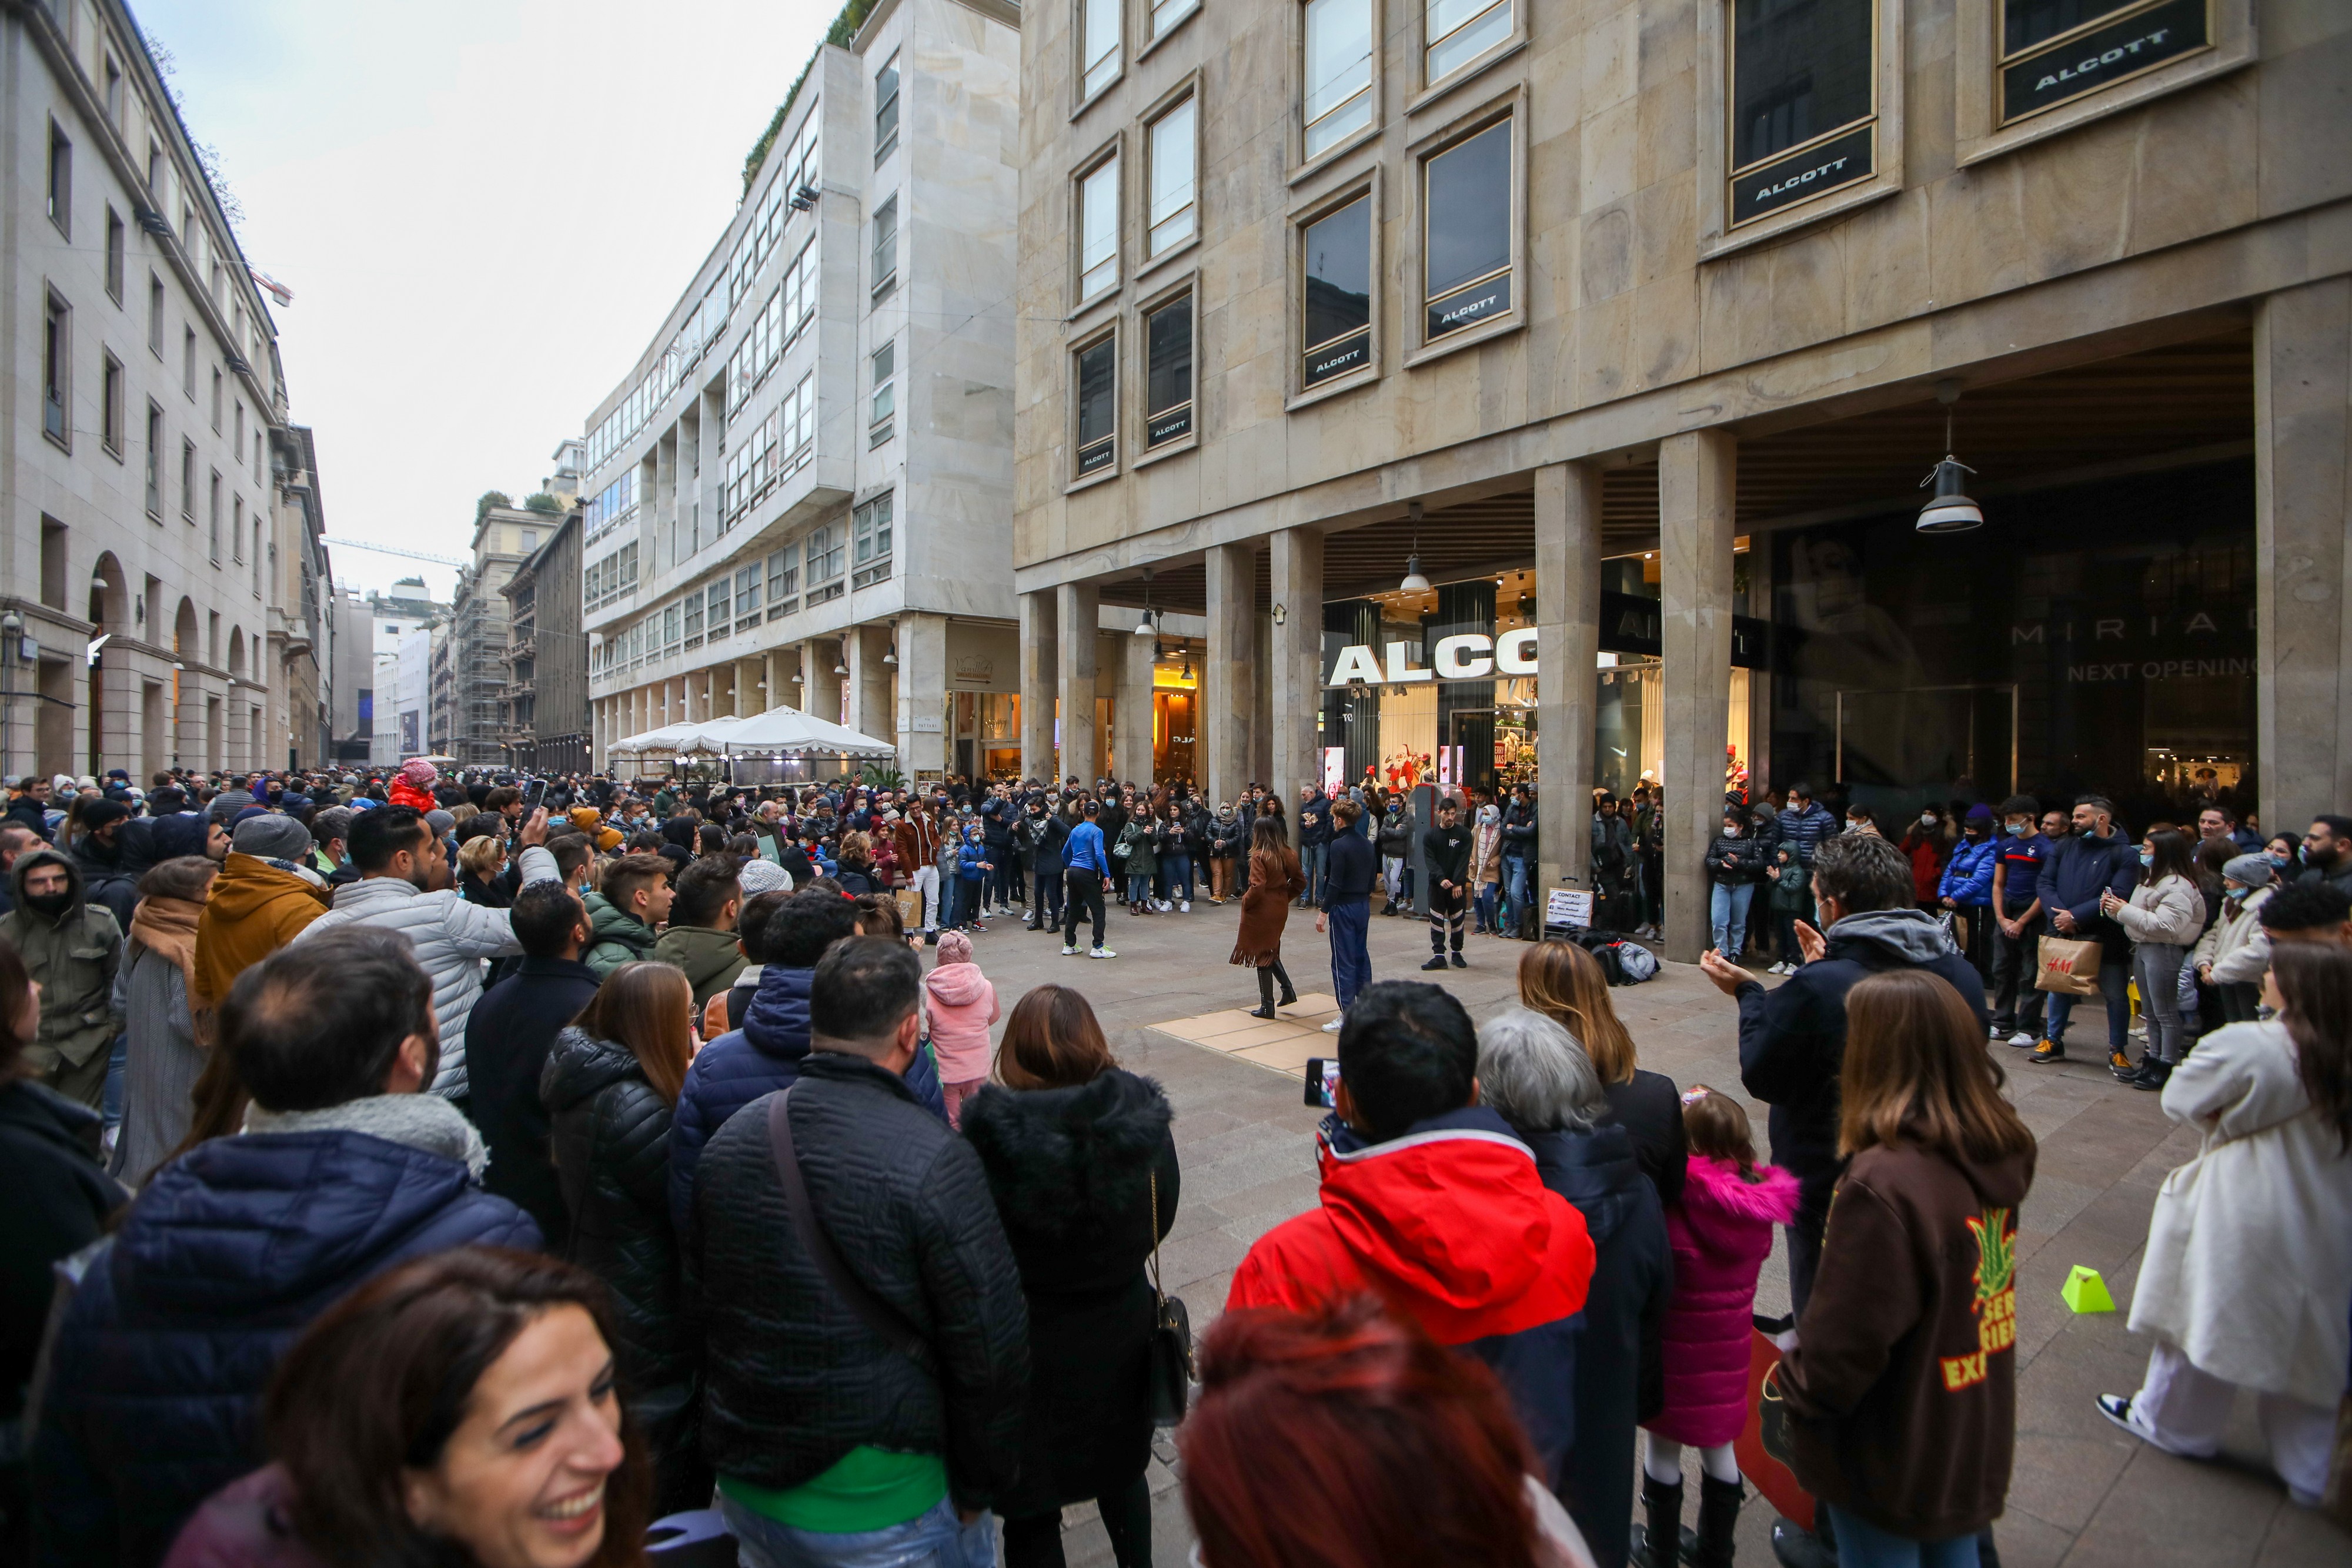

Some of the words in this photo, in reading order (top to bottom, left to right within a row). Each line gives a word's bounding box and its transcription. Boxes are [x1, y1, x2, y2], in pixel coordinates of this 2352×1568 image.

[2035, 29, 2169, 91] ALCOTT
[1755, 156, 1847, 201] ALCOTT
[1441, 295, 1497, 323] ALCOTT
[1315, 349, 1360, 373] ALCOTT
[1155, 420, 1186, 437] ALCOTT
[1084, 451, 1110, 466] ALCOTT
[1329, 628, 1619, 686] ALCO
[2067, 662, 2134, 683] NEXT
[1495, 745, 1505, 754] ERRY
[1495, 754, 1505, 764] MAS
